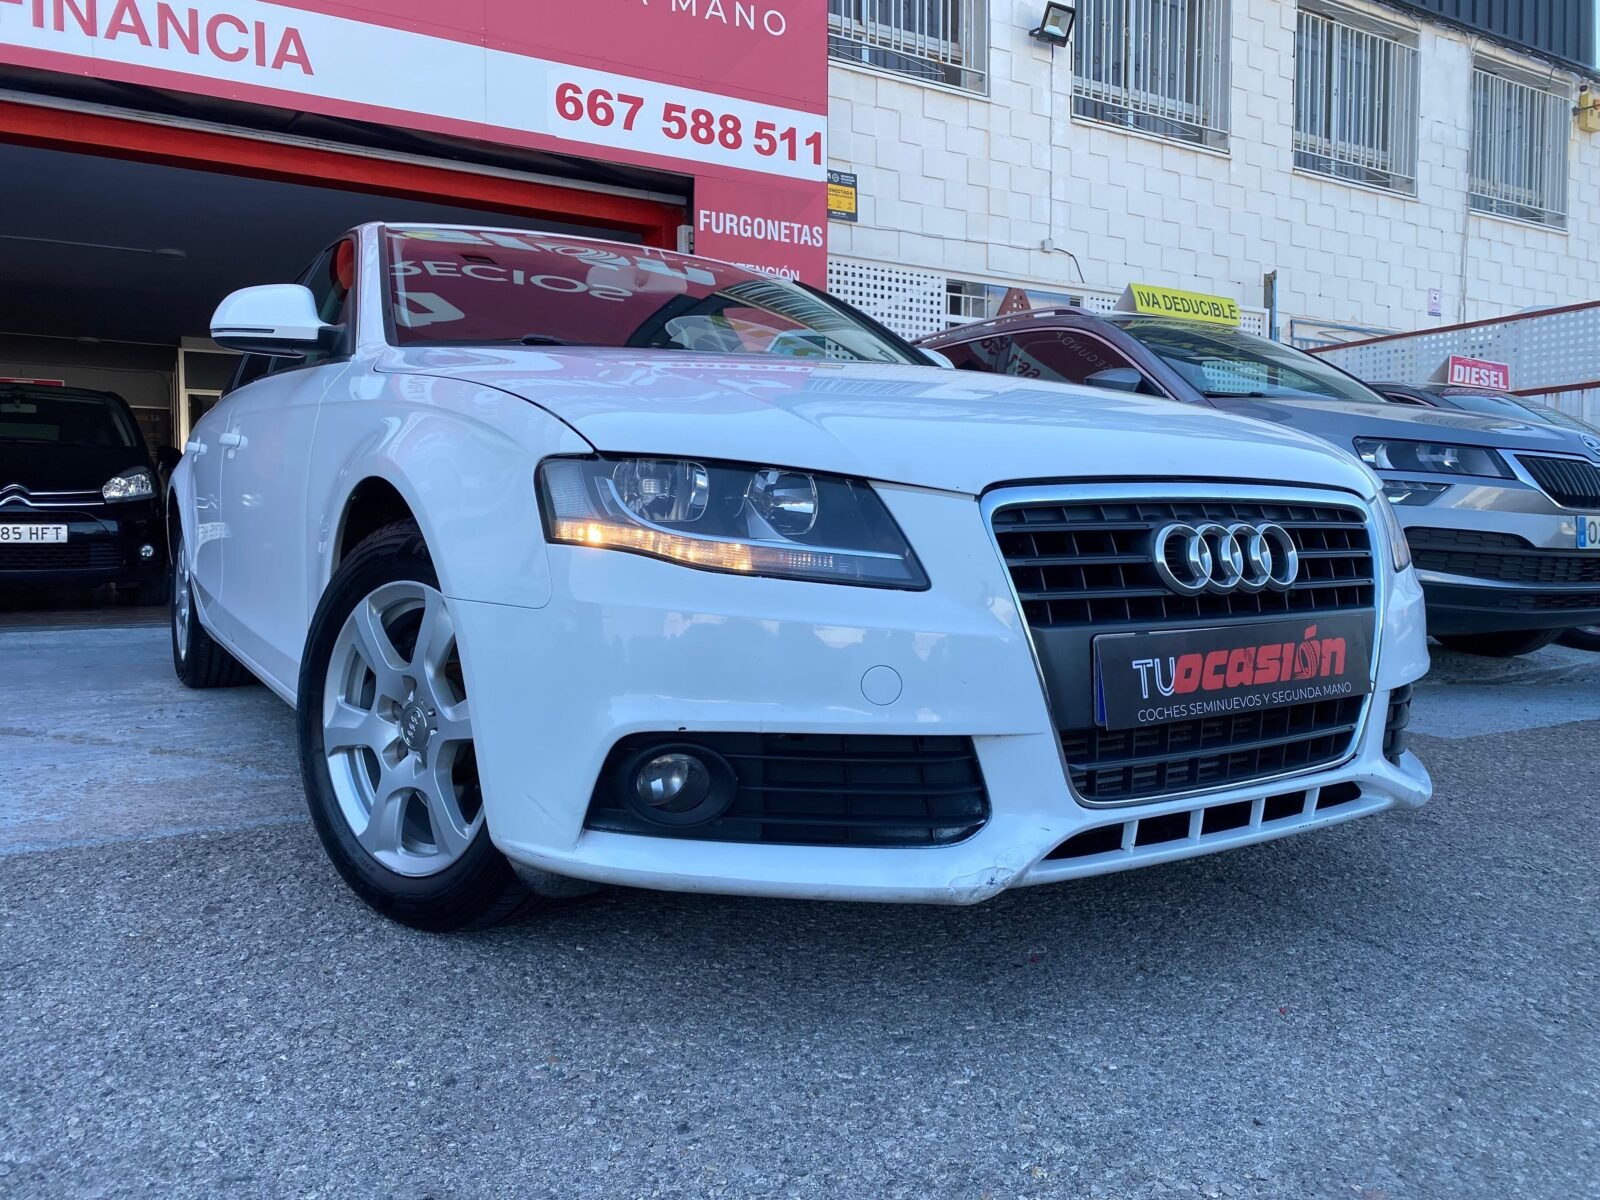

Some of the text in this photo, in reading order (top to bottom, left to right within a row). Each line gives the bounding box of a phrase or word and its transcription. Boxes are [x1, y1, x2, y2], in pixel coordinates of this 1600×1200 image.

[0, 0, 314, 76] INANCIA
[555, 83, 822, 165] 667 588 511
[699, 210, 823, 247] FURGONETAS
[1137, 290, 1238, 321] IVA DEDUCIBLE
[1453, 364, 1507, 389] DIESEL
[29, 527, 62, 541] HFT
[1138, 681, 1352, 722] COCHES SEMINUEVOS Y SEGUNDA MANO
